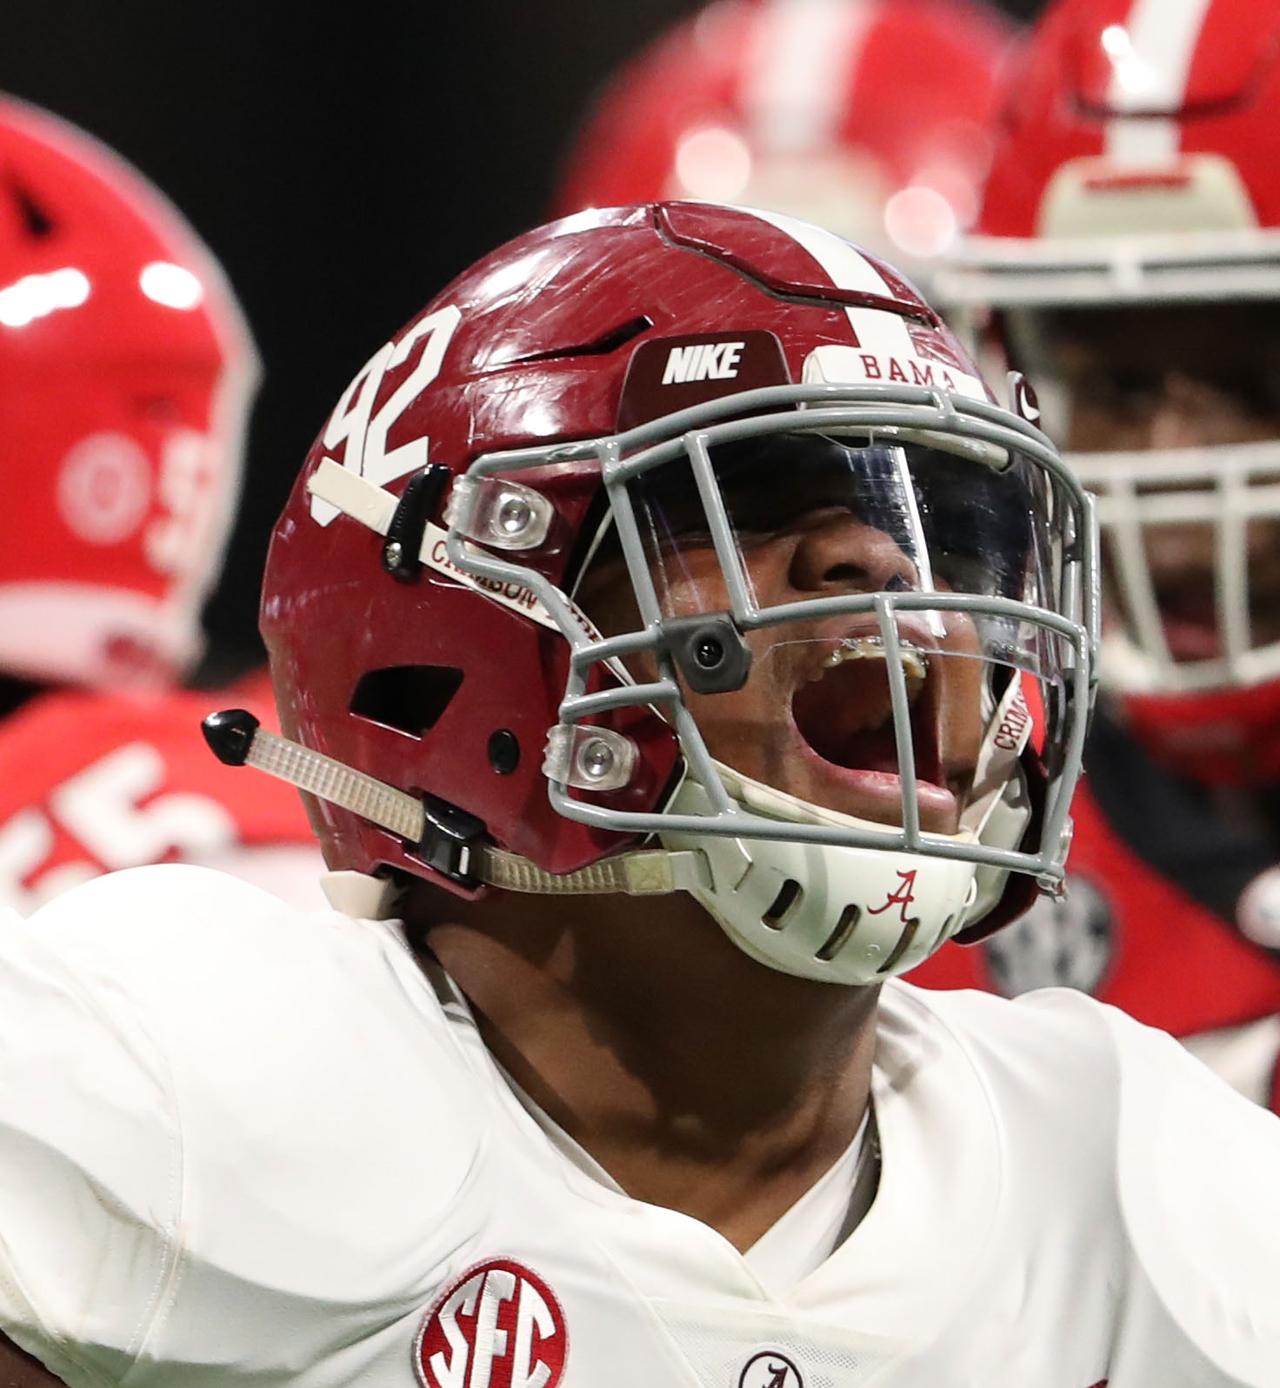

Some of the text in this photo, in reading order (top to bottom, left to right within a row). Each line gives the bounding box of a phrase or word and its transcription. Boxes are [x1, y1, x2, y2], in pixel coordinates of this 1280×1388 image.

[661, 341, 745, 385] NIKE
[858, 353, 958, 392] BAMA
[310, 304, 462, 528] 92
[866, 868, 917, 923] A
